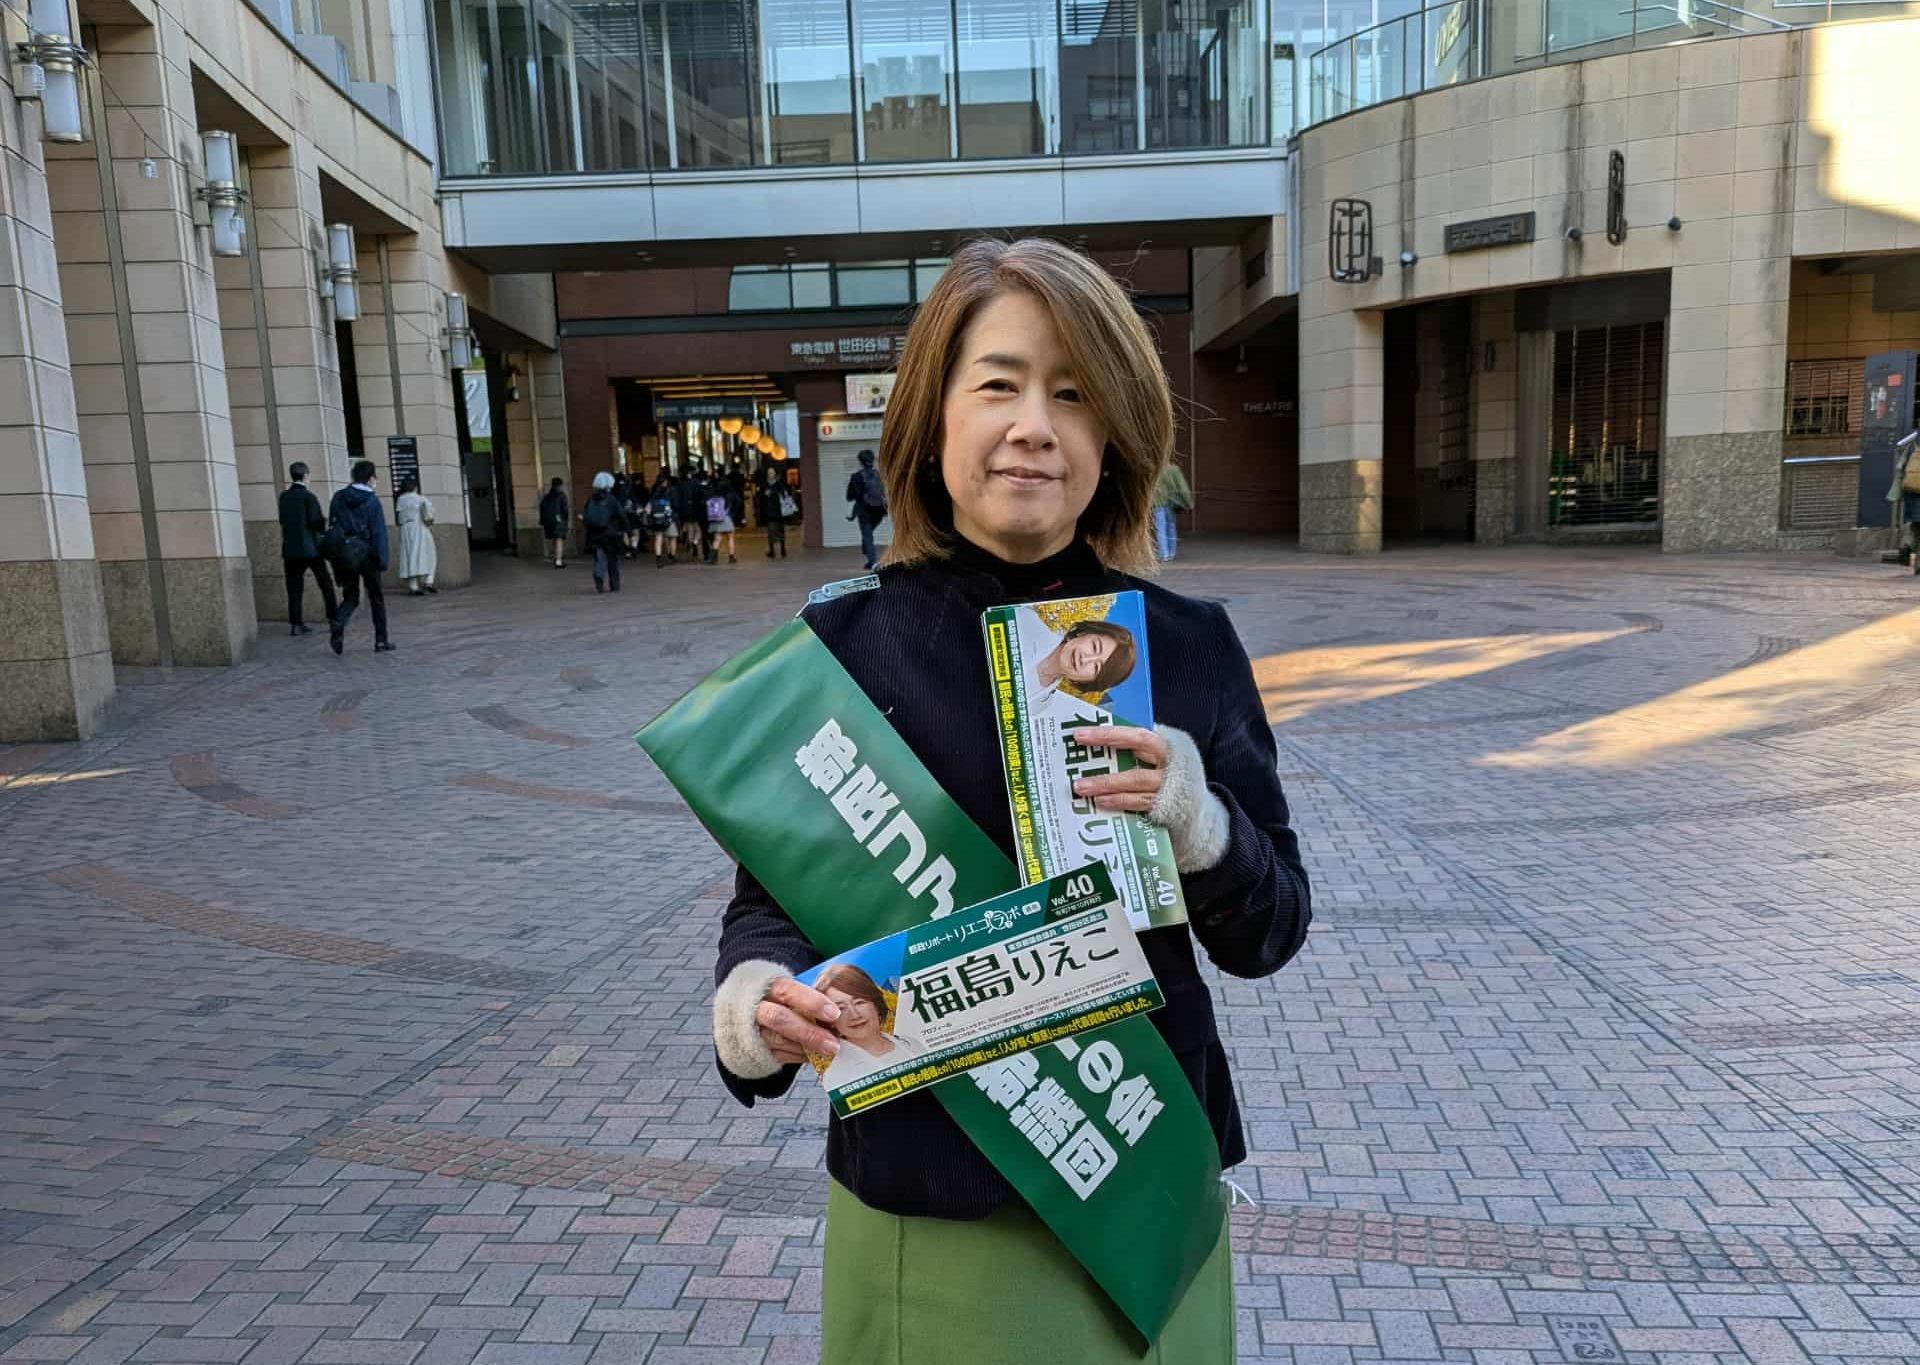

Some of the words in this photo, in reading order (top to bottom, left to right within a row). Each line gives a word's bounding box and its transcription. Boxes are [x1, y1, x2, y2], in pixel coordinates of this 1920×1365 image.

[901, 927, 1119, 1024] 福島りえこ
